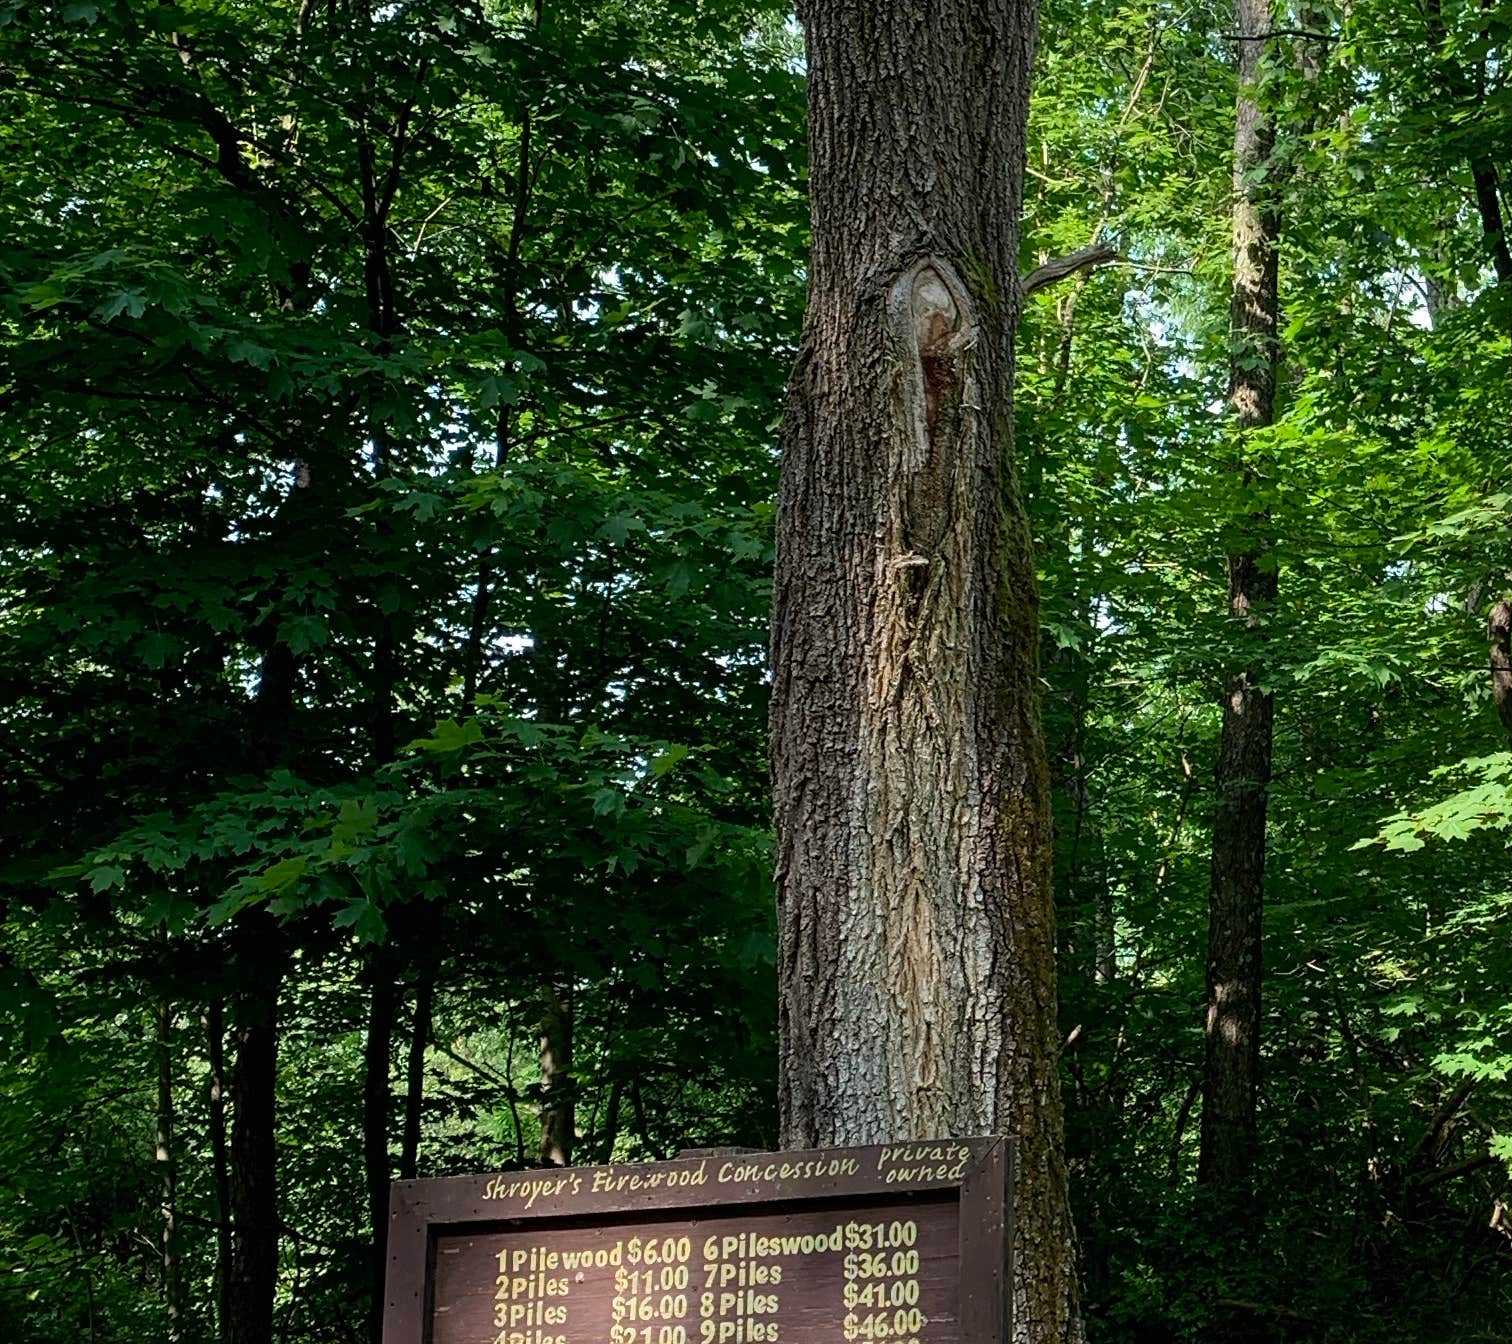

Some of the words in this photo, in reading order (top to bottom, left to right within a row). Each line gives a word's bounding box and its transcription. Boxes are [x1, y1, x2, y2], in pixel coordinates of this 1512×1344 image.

[877, 1142, 971, 1171] private
[591, 1160, 708, 1194] Firewood
[718, 1158, 859, 1183] Concession
[886, 1160, 966, 1184] owned
[845, 1220, 917, 1250] $31.00
[627, 1236, 691, 1265] $6.00
[843, 1249, 919, 1280] $36.00
[615, 1265, 689, 1295] $11.00
[612, 1294, 687, 1323] $16.00
[843, 1280, 920, 1311] $41.00
[843, 1308, 921, 1341] $46.00
